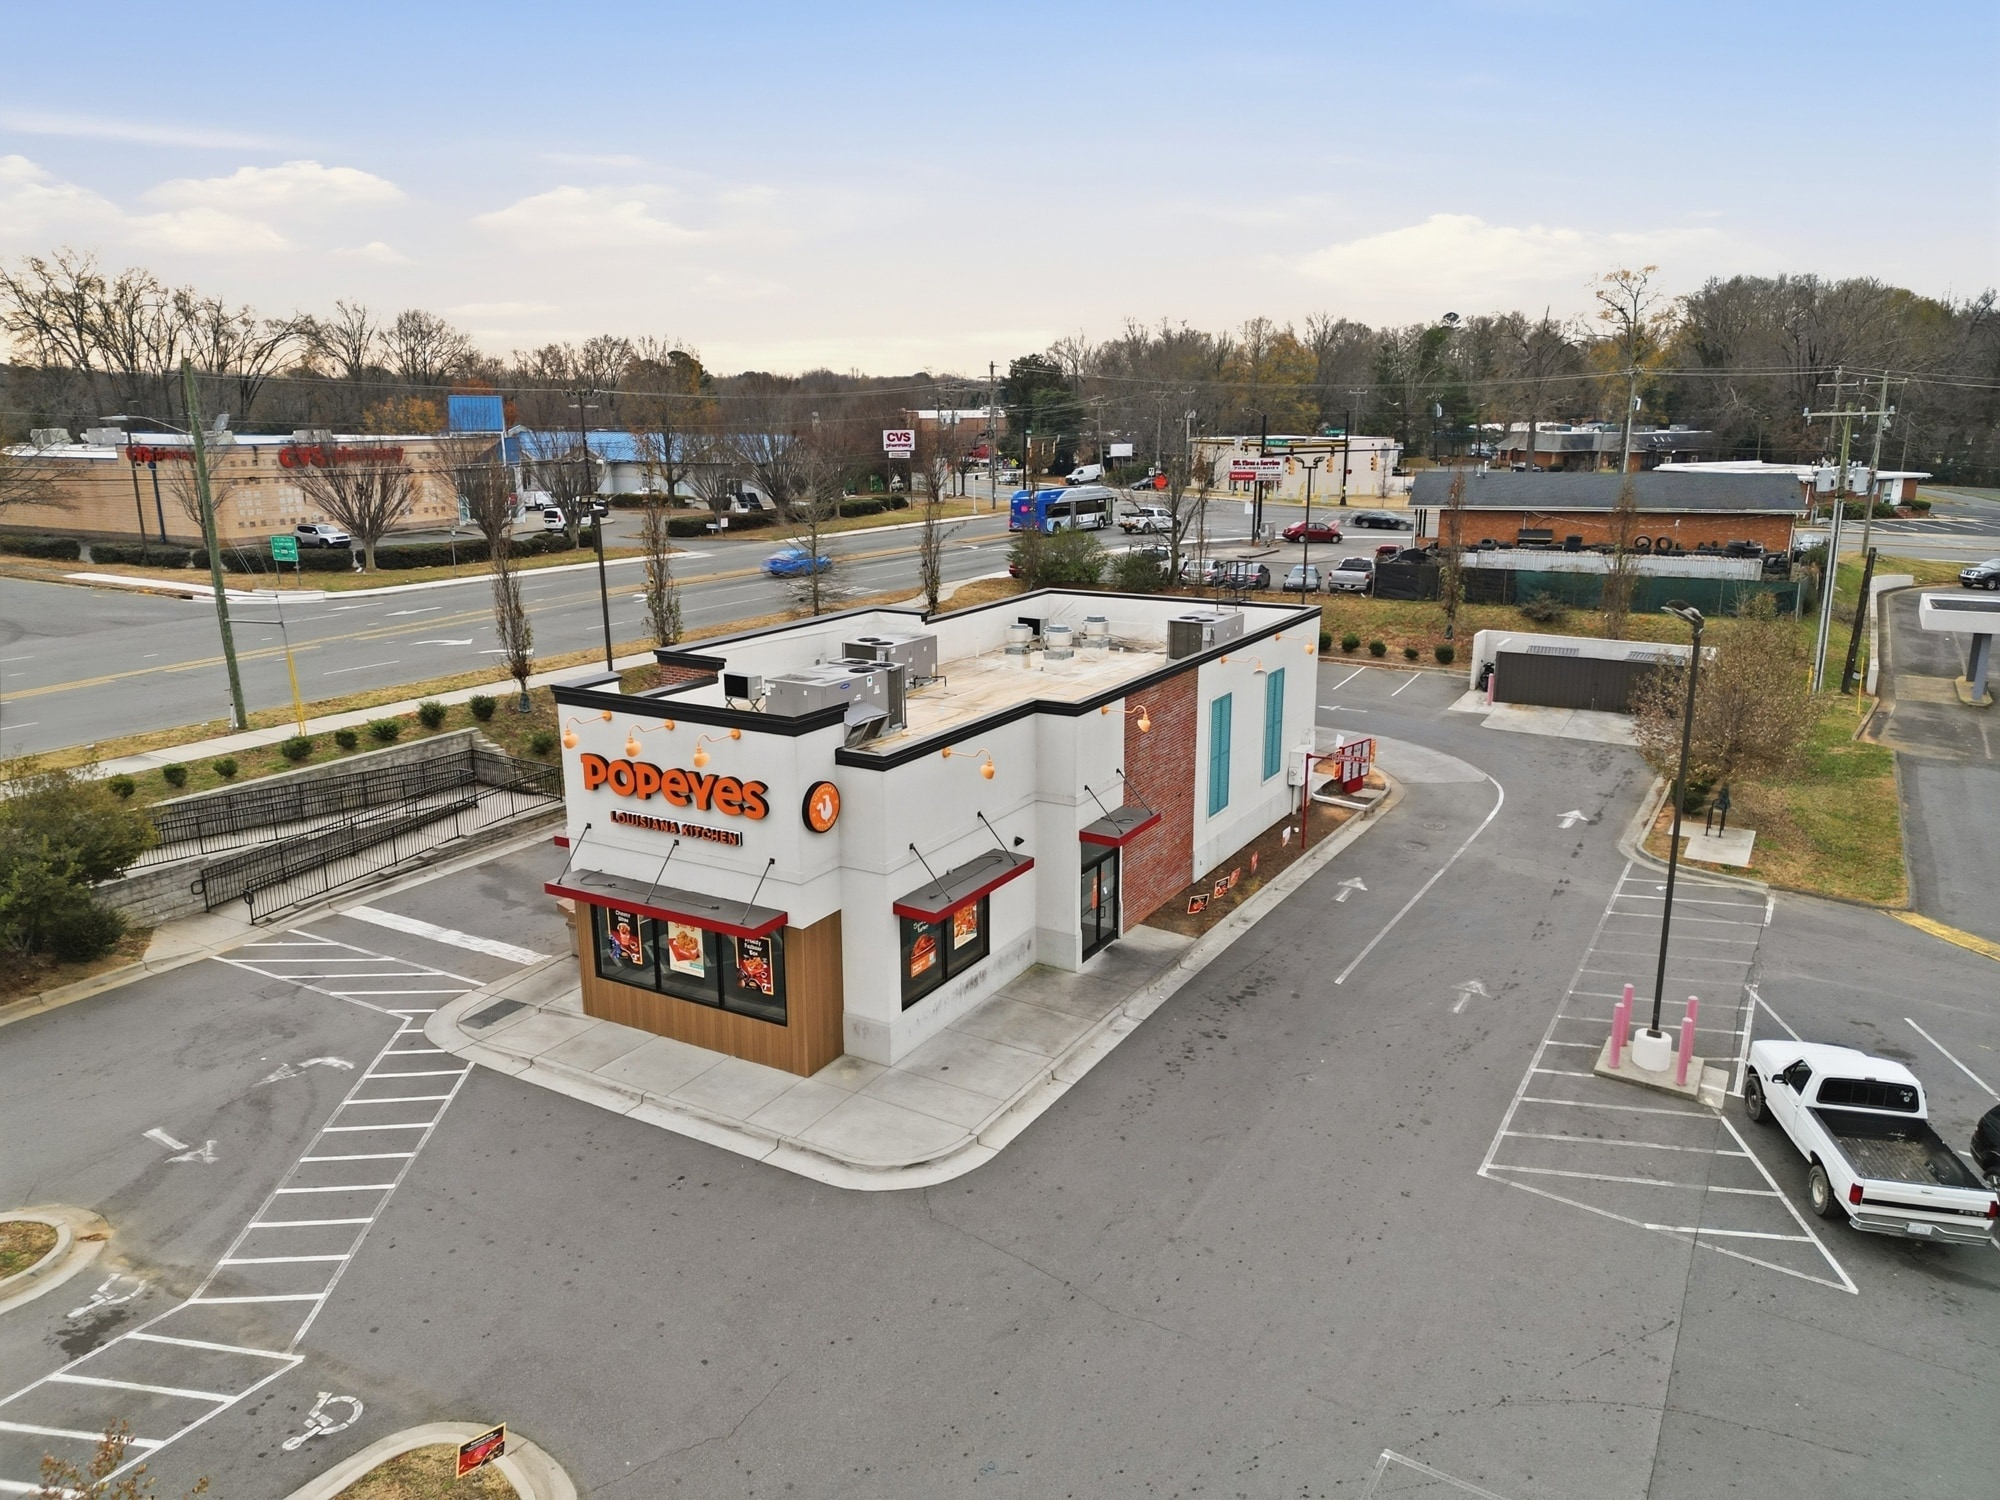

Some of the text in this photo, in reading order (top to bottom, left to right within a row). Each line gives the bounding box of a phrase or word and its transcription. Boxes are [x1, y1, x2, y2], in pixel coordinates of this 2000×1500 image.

[887, 432, 911, 442] CVS
[610, 810, 741, 846] LOUISIANA KITCHEN
